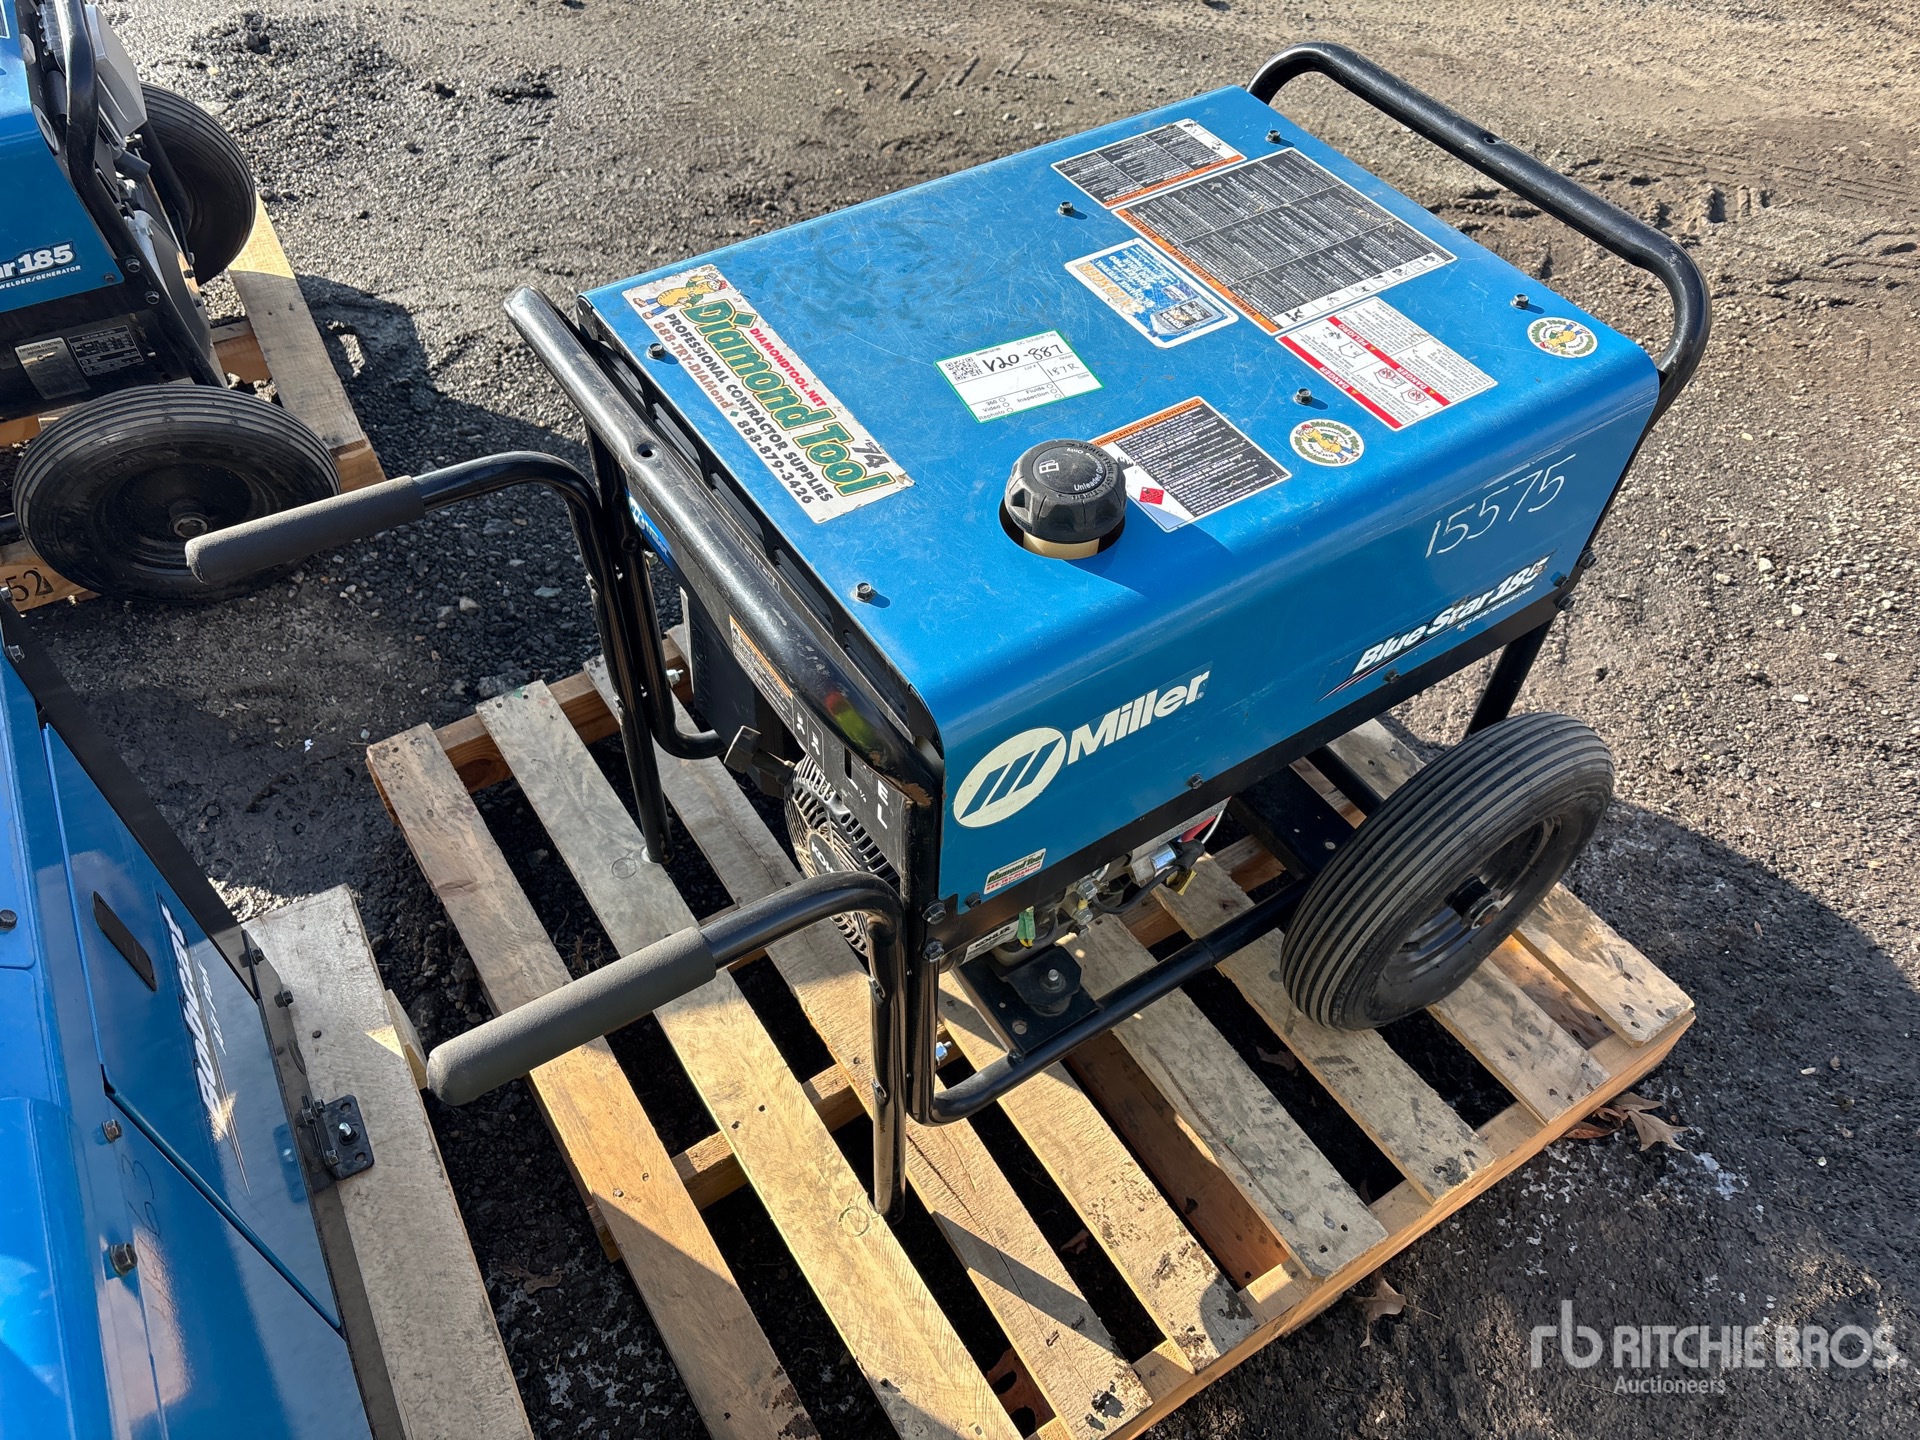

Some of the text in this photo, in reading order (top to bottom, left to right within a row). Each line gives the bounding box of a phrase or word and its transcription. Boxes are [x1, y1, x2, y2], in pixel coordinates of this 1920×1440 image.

[18, 244, 73, 273] 185
[1093, 259, 1122, 281] INTERVAL
[1107, 255, 1125, 267] PRO
[1168, 249, 1213, 281] AVERTISSEMENT
[0, 265, 81, 289] WELDER/GENERATOR
[1077, 263, 1126, 299] LONGER
[1228, 295, 1257, 316] WARNING
[41, 340, 63, 349] CONTROL
[1336, 323, 1369, 346] PELIGRO
[749, 328, 827, 407] DIAMONDTOOL.NET
[1317, 365, 1350, 389] DANGER
[1395, 366, 1428, 389] DANGER
[680, 299, 896, 497] Diamond Tool
[982, 390, 1050, 412] Video Inspection
[1025, 386, 1046, 394] Fluids
[664, 313, 834, 502] PROFESSIONAL CONTRACTOR SUPPLIES
[978, 409, 1006, 420] Rephoto
[737, 420, 814, 504] 888-879-3426
[1074, 472, 1102, 491] Unleaded
[1425, 453, 1576, 558] 15575
[1352, 624, 1426, 674] Blue
[1426, 590, 1492, 635] Star
[1067, 670, 1210, 765] Miller
[987, 861, 1026, 883] Diamond
[1027, 852, 1044, 866] Tool
[975, 926, 1011, 948] KOHLER
[160, 897, 229, 1138] Bobcat
